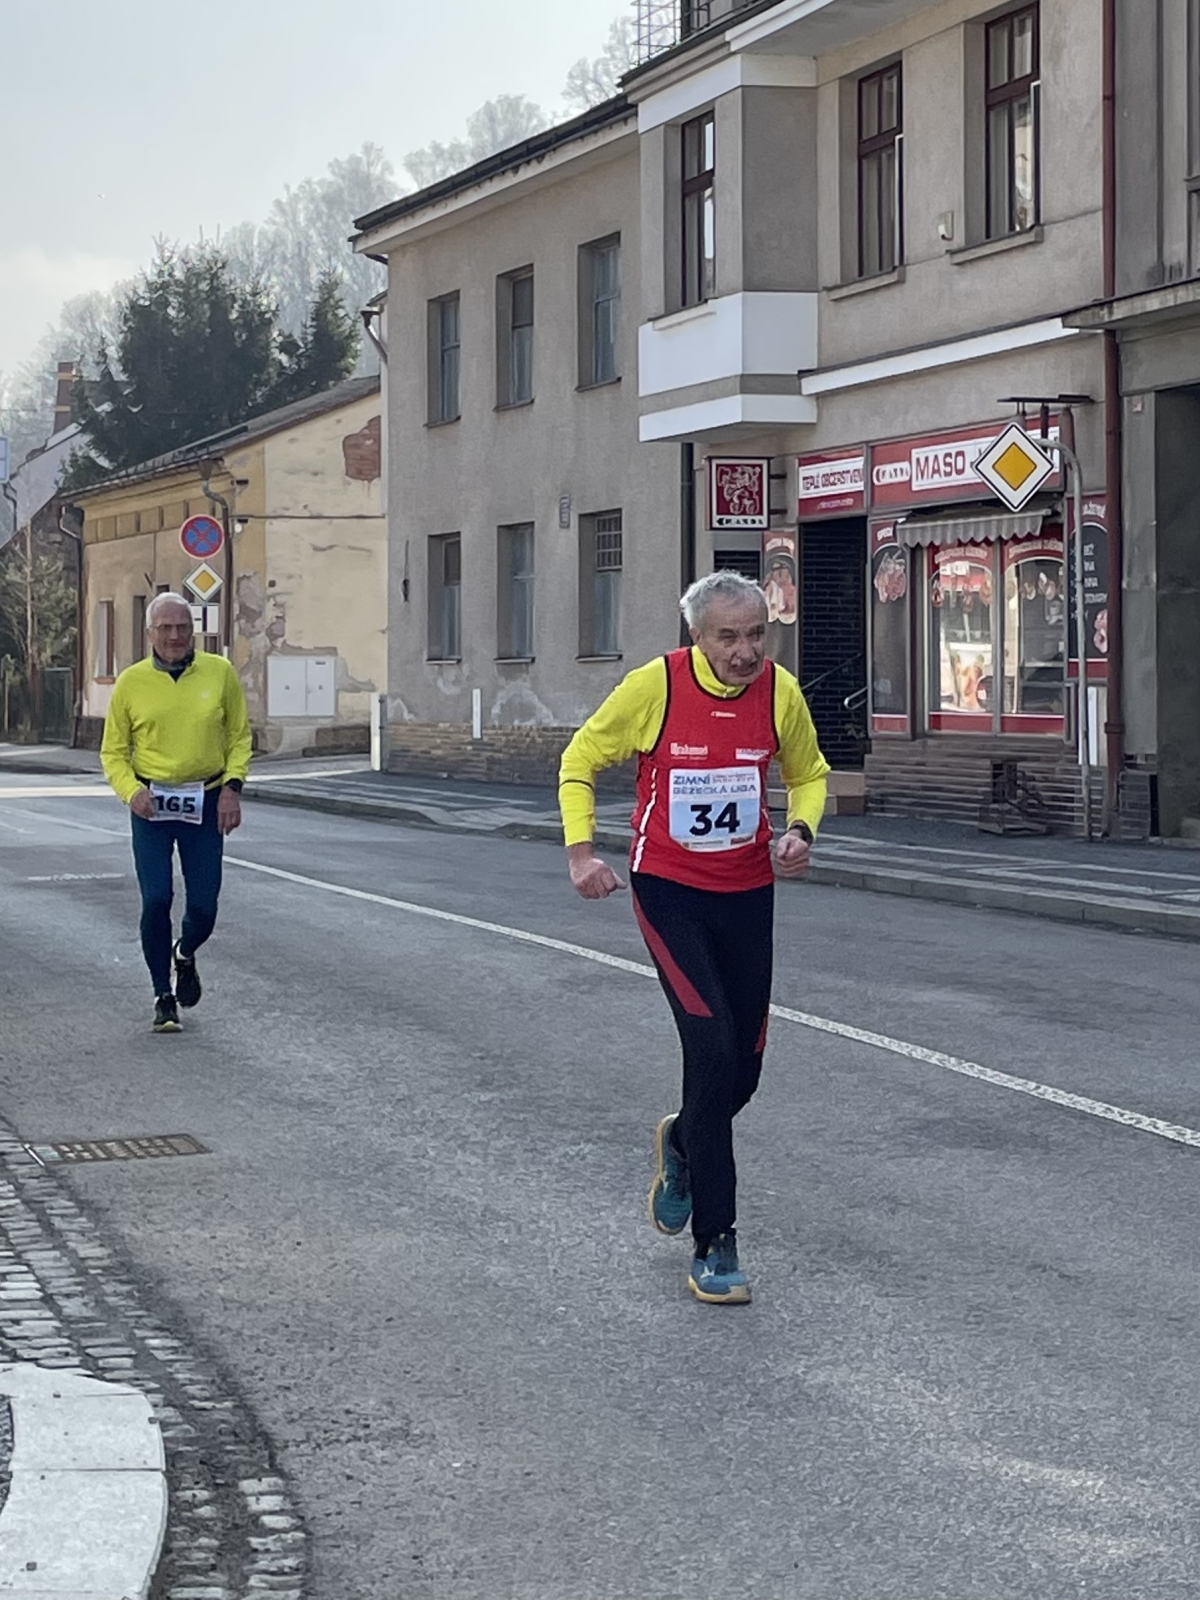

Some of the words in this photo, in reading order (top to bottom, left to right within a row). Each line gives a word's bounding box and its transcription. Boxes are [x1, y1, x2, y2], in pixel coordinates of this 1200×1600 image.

[916, 450, 966, 482] MASO
[673, 773, 710, 785] ZIMNÍ
[154, 795, 196, 813] 165
[689, 802, 741, 836] 34
